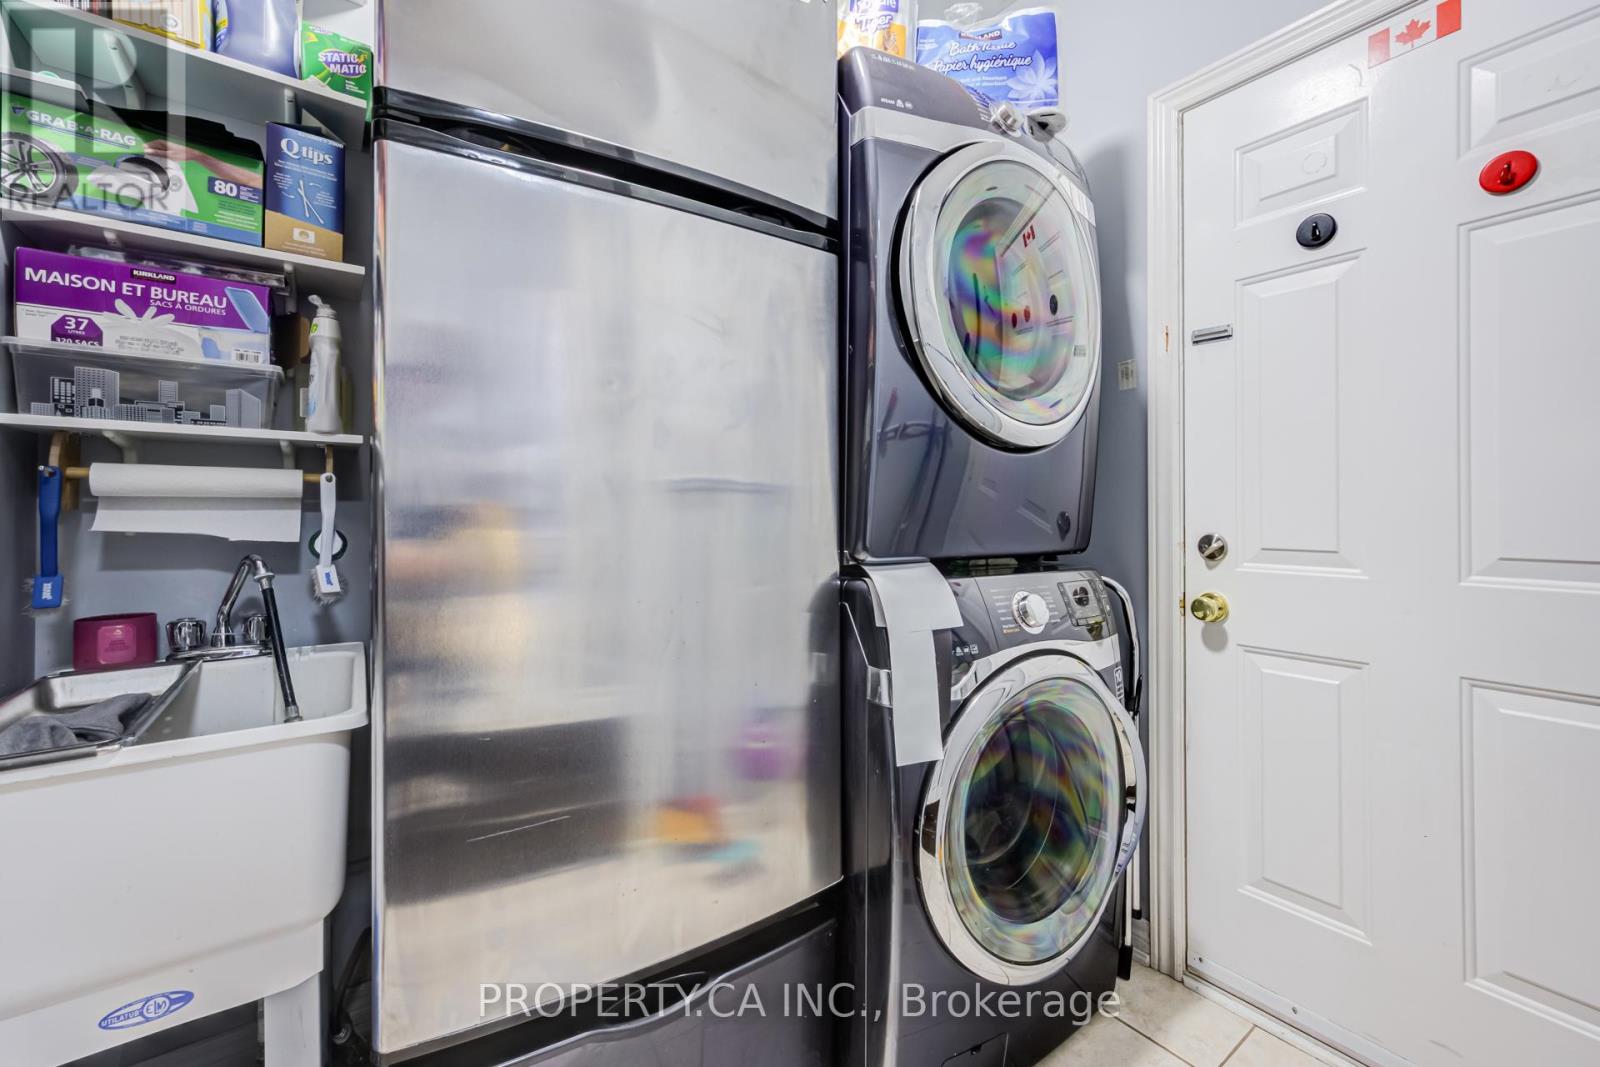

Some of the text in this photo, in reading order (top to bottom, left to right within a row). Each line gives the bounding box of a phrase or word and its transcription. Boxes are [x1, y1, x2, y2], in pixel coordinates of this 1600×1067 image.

[950, 41, 981, 55] Bath
[318, 52, 358, 63] STATIC
[934, 54, 1032, 75] Papier hygiénique
[329, 63, 367, 75] MATIC
[214, 180, 238, 197] 80
[133, 269, 175, 281] KIRKLAND
[25, 267, 227, 308] MAISON ET BUREAU
[150, 299, 173, 309] SACS
[185, 304, 227, 315] ORDURES
[64, 317, 89, 331] 37
